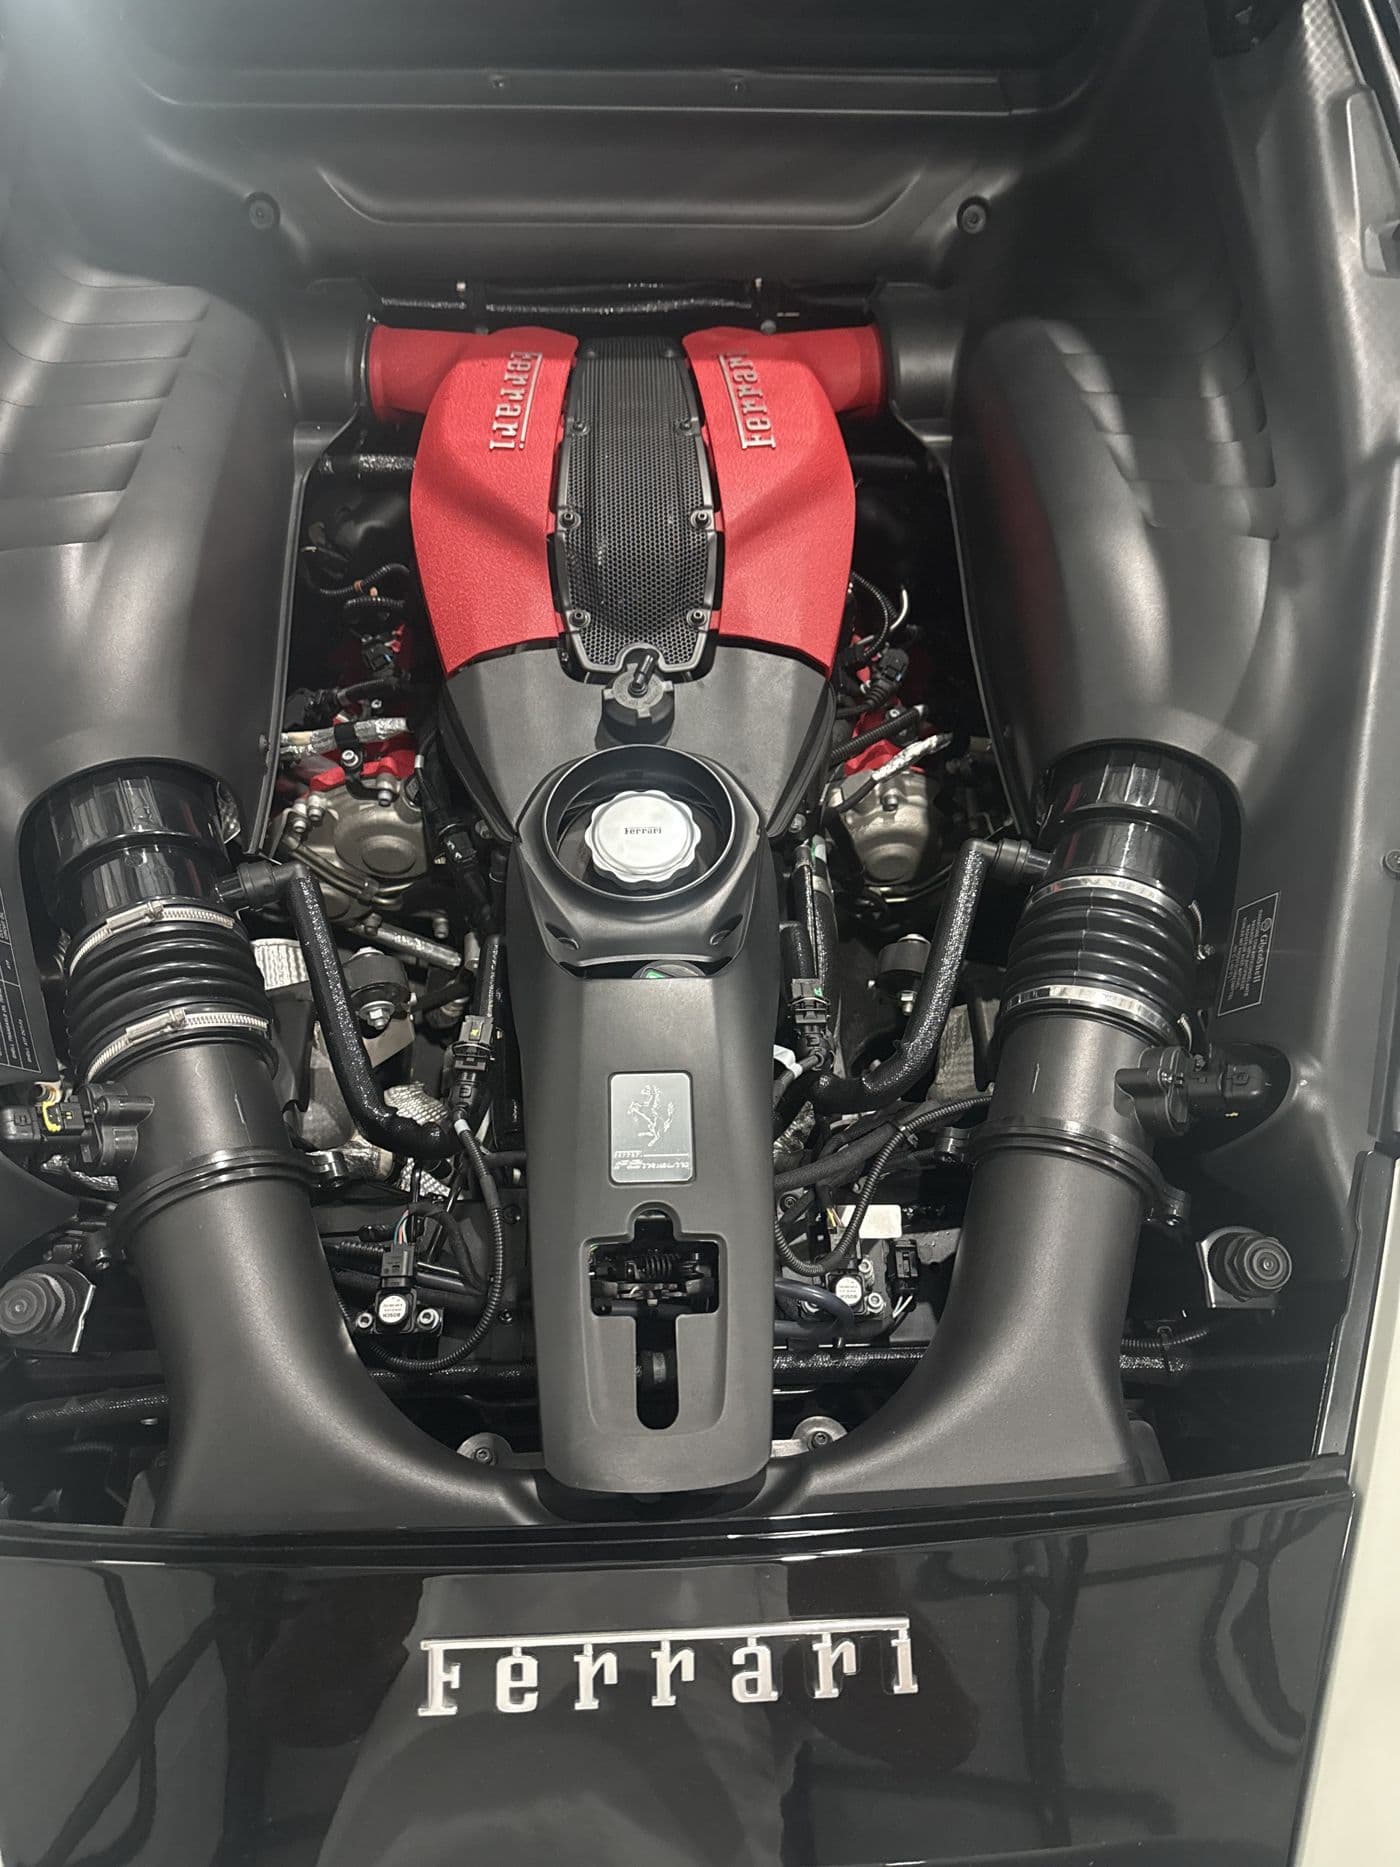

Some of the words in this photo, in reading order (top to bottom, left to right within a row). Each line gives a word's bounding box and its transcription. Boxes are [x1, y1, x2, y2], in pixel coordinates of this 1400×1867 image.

[489, 351, 543, 450] Ferrari
[717, 351, 776, 450] Ferrari
[624, 826, 662, 835] Ferrari
[1253, 934, 1268, 983] GlycoShell
[418, 1618, 919, 1716] Ferrari
